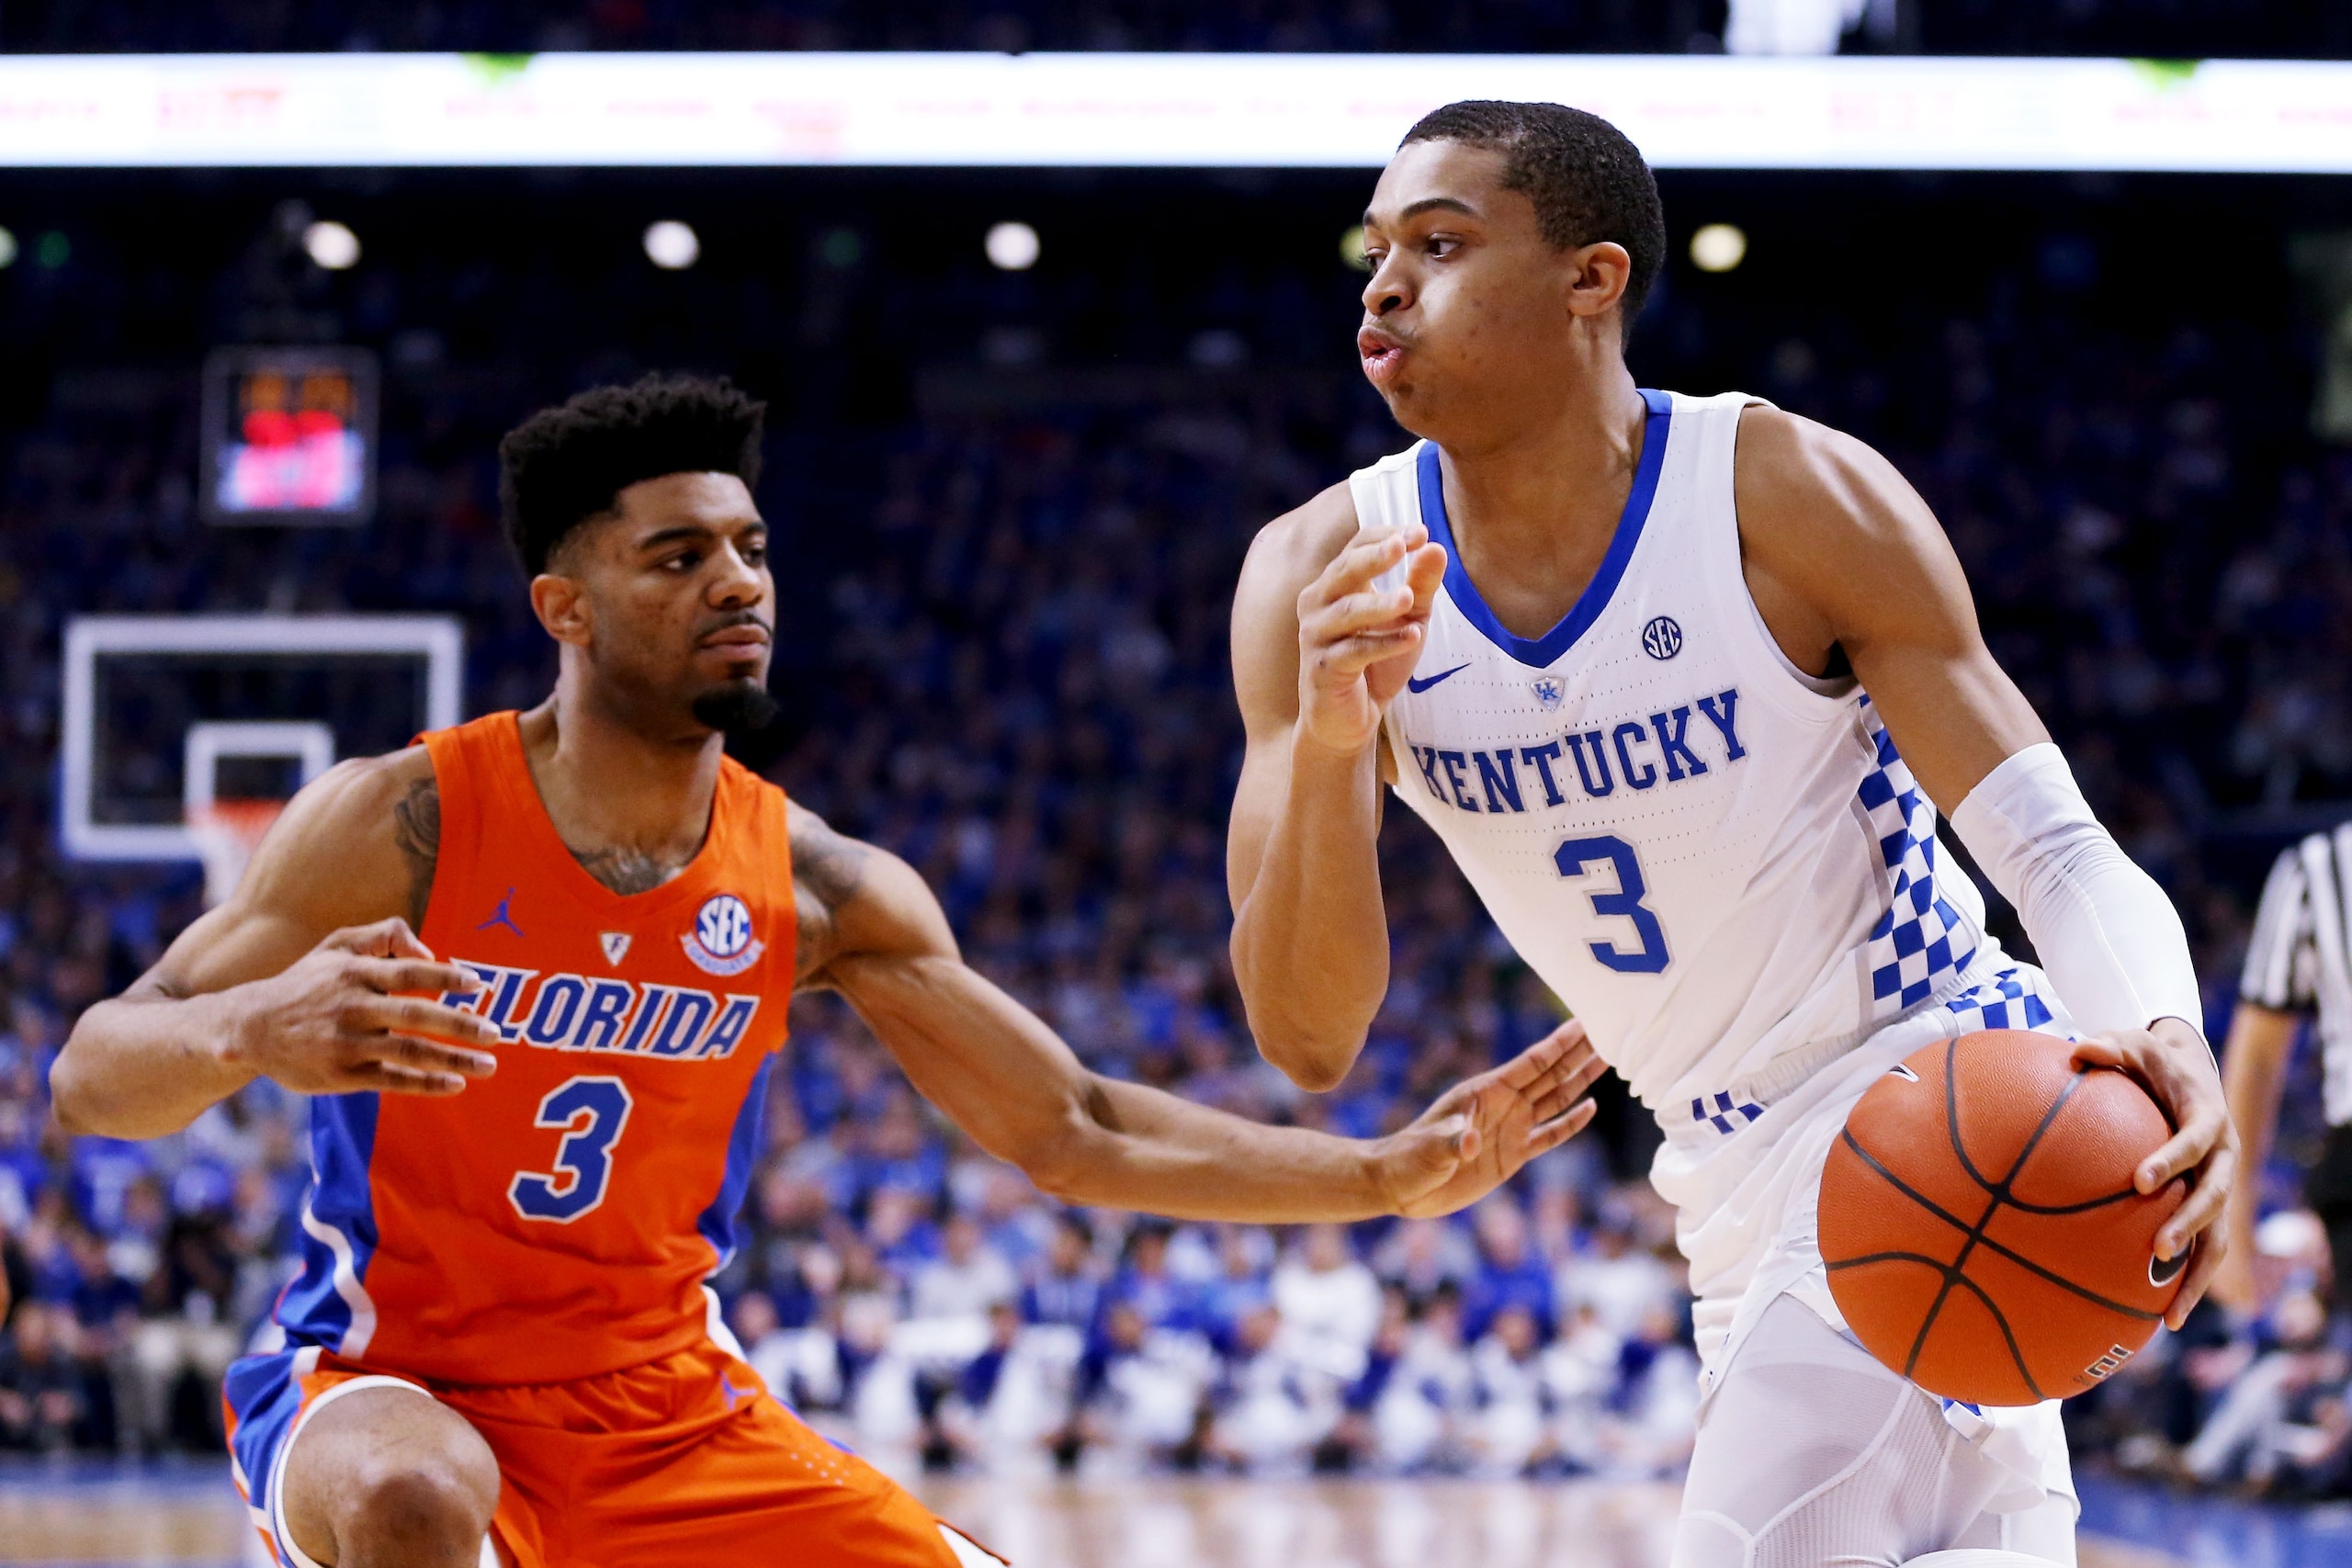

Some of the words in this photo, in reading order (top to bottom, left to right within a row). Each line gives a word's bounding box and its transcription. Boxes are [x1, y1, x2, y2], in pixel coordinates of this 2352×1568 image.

[1644, 617, 1681, 659] SEC
[1409, 688, 1747, 814] KENTUCKY
[697, 896, 751, 956] SEC
[1552, 832, 1672, 976] 3
[506, 1076, 633, 1224] 3
